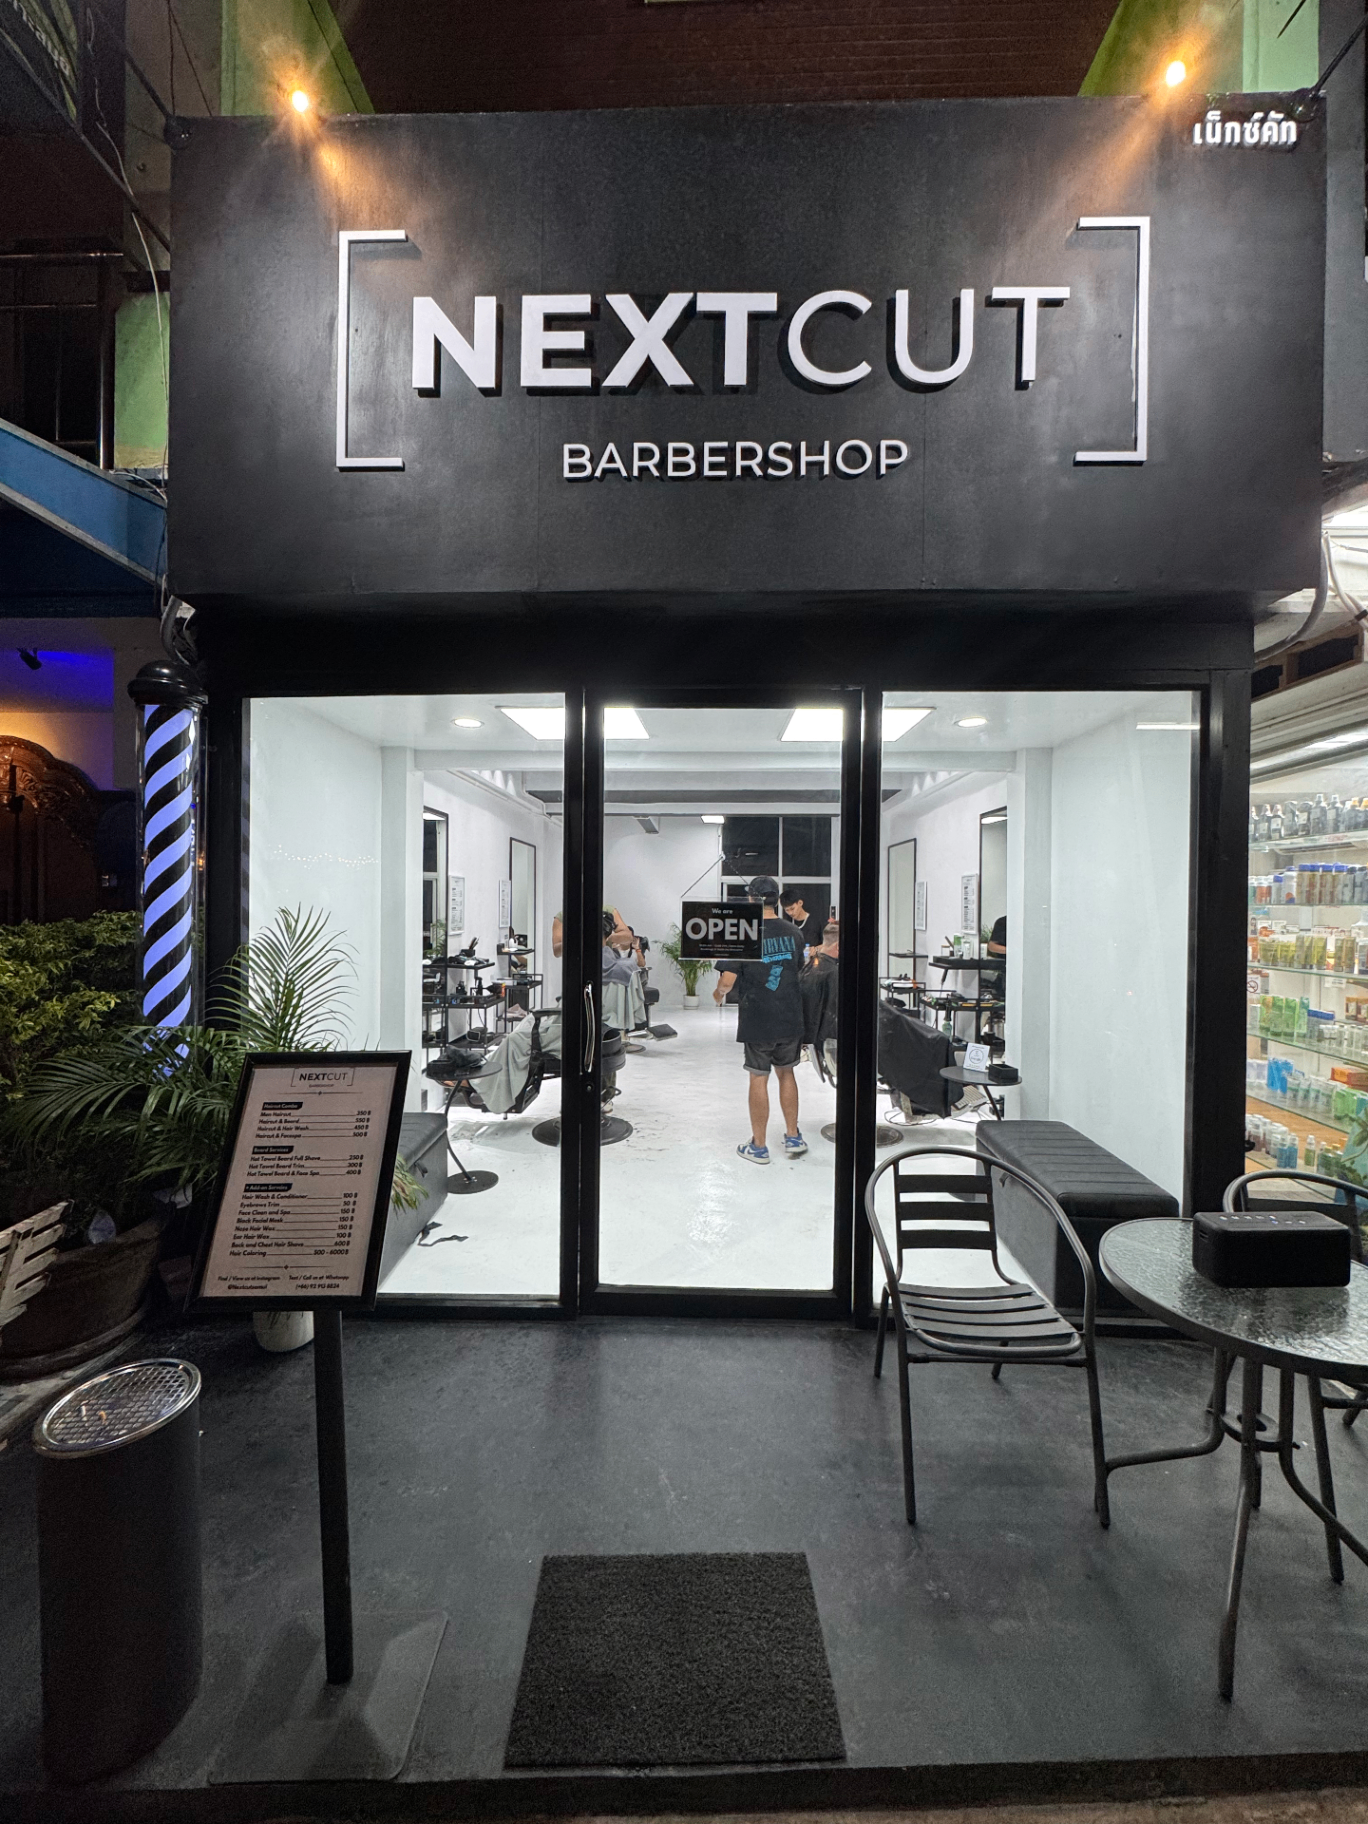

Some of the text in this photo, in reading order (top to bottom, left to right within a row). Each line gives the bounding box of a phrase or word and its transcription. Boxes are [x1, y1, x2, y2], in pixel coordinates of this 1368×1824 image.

[411, 287, 1071, 389] NEXTCUT
[564, 440, 907, 477] BARBERSHOP
[686, 918, 758, 940] OPEN
[763, 936, 796, 954] IRVANA
[299, 1073, 348, 1081] NEXTCUT
